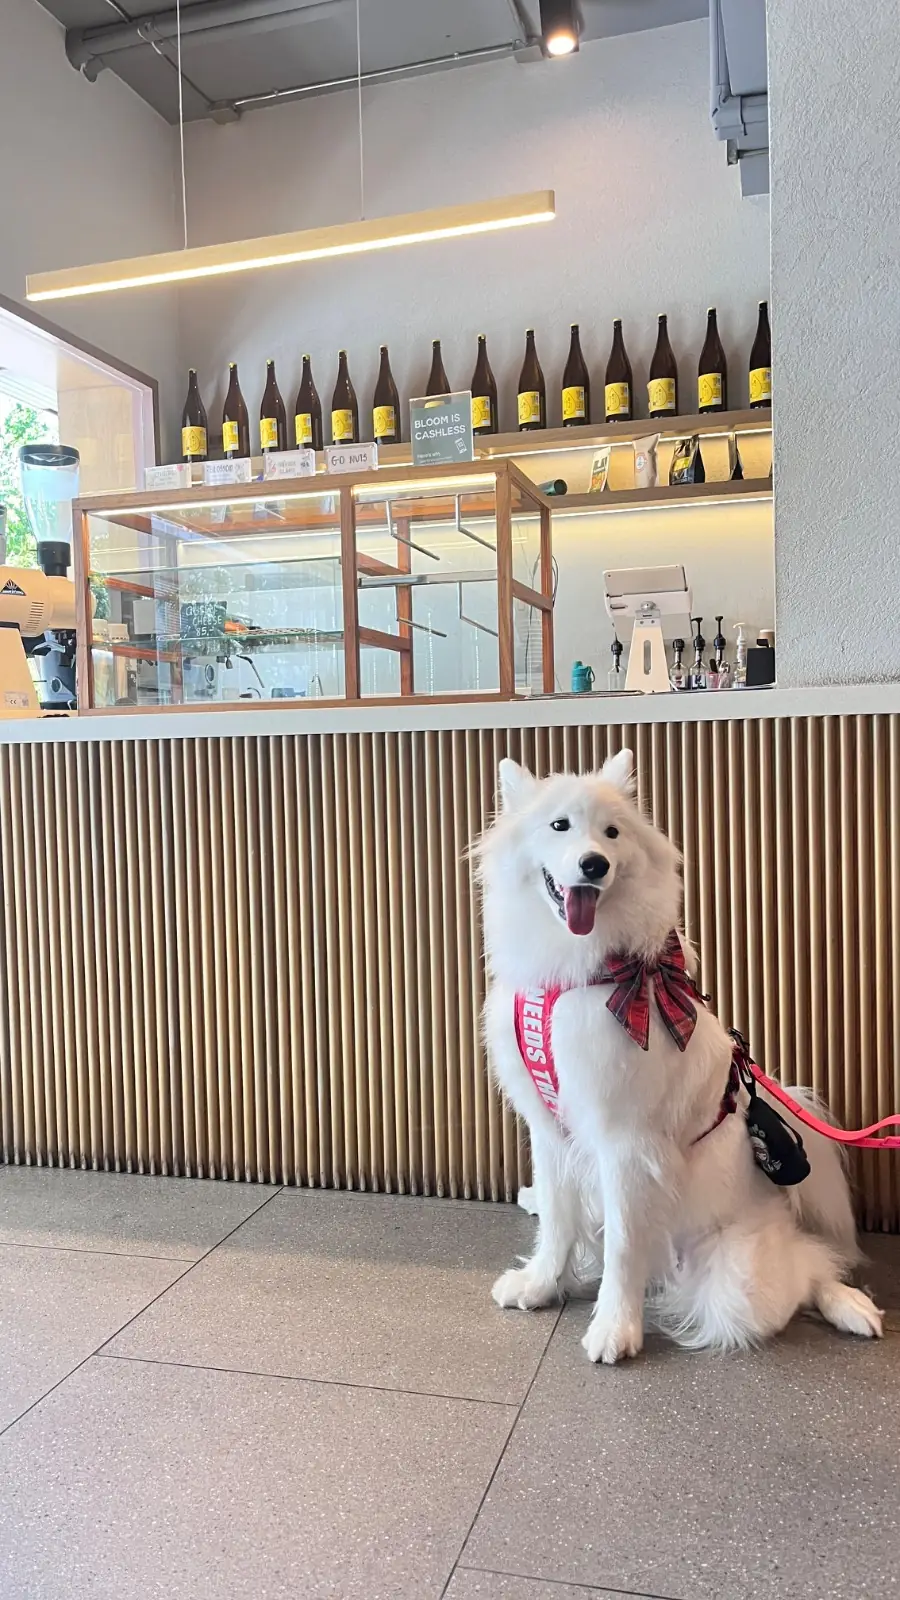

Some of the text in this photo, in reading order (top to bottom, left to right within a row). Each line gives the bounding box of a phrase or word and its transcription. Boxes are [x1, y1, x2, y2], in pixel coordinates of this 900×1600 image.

[414, 413, 461, 429] BLOOM IS
[415, 425, 466, 441] CASHLESS
[523, 985, 547, 1065] NEEDS
